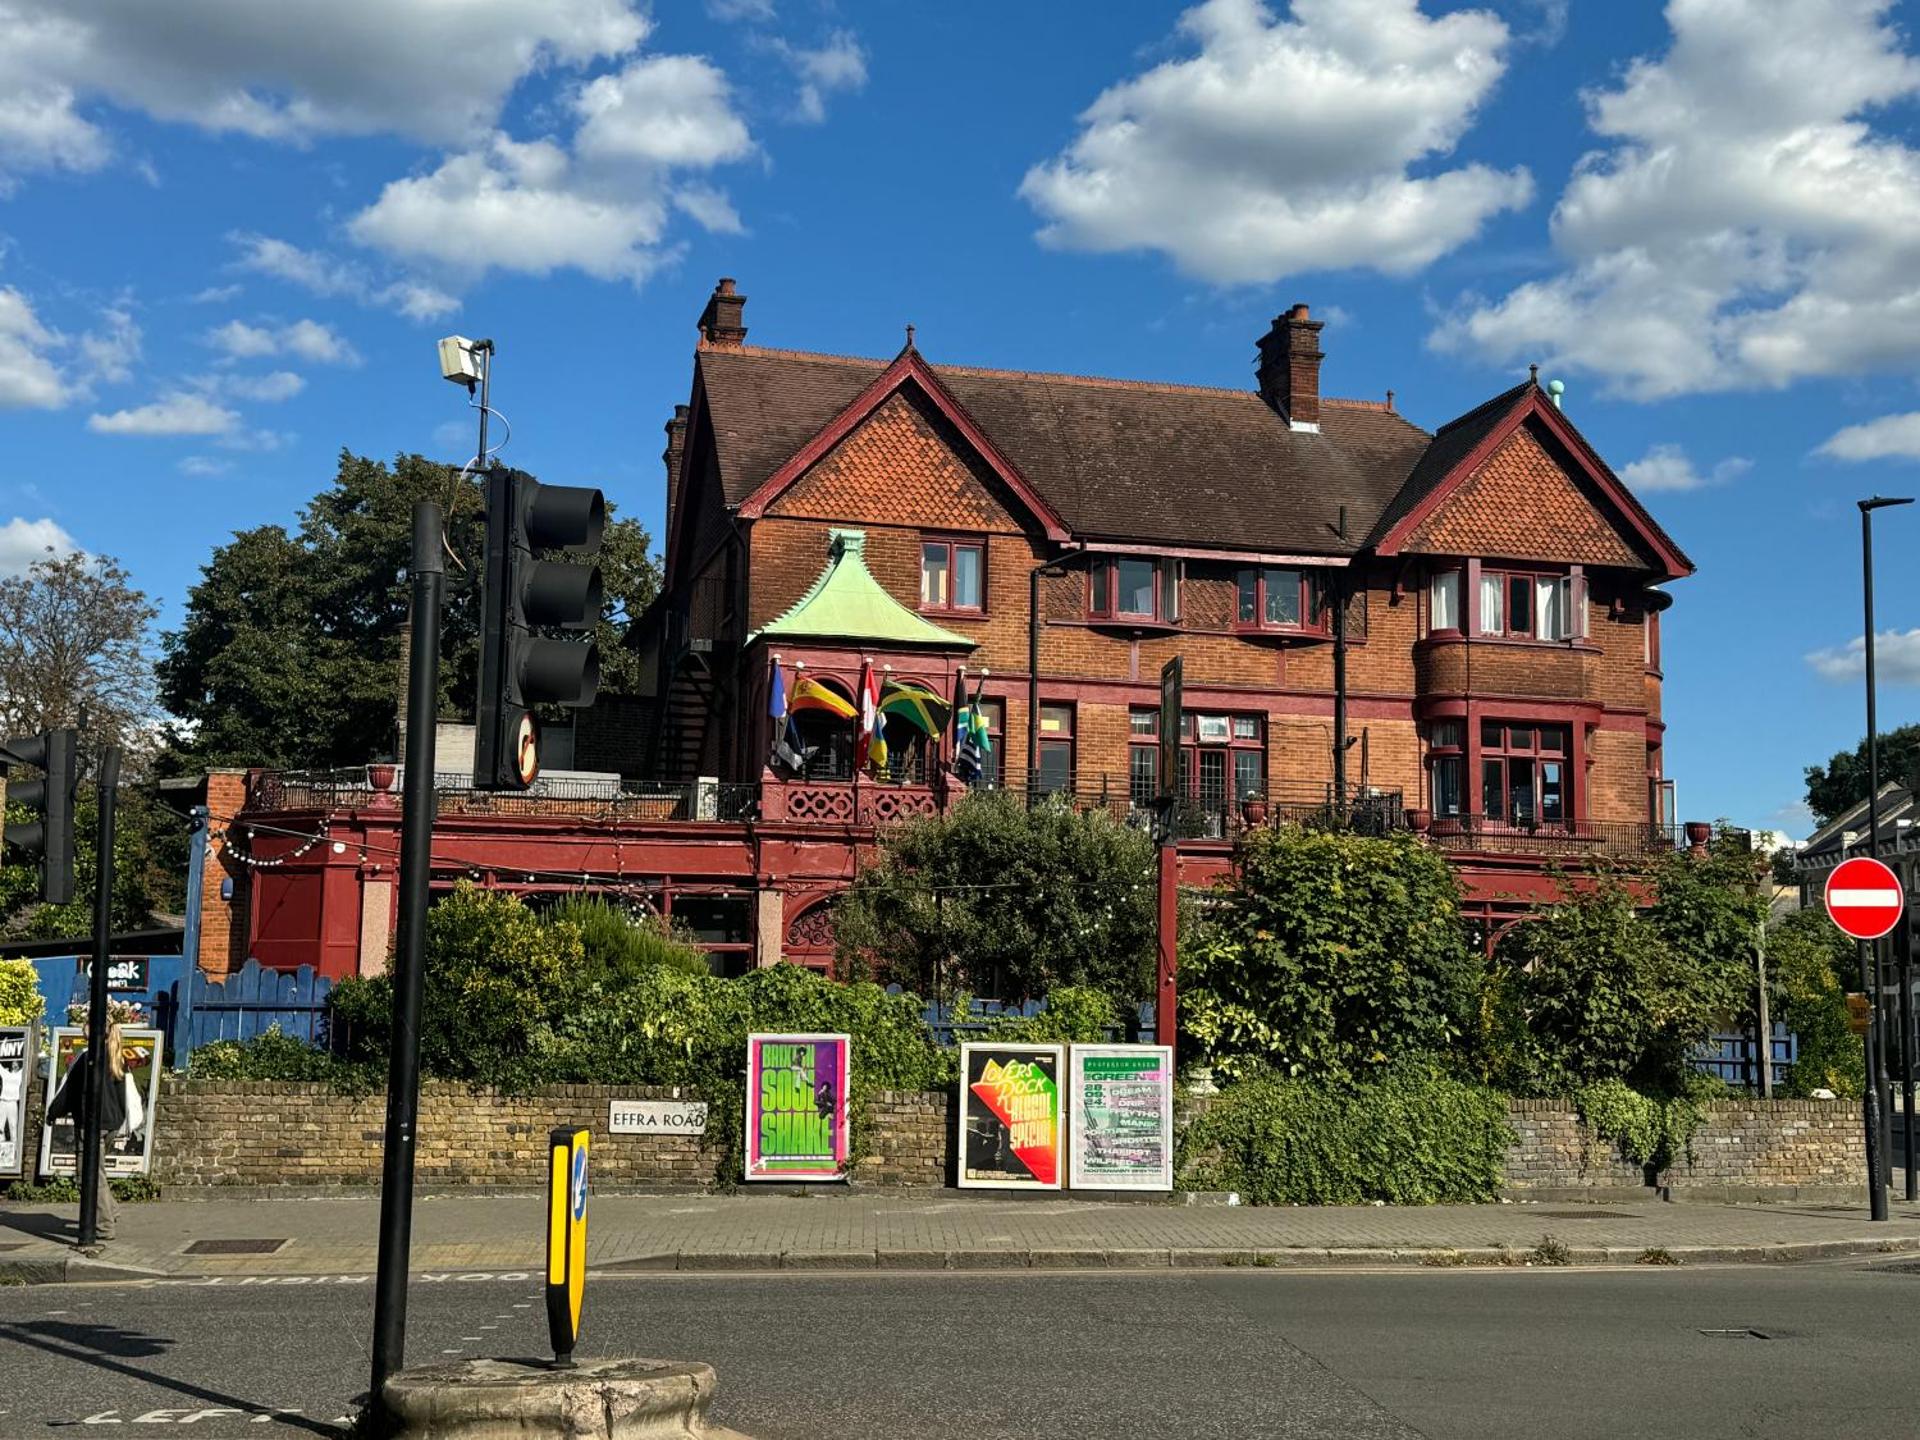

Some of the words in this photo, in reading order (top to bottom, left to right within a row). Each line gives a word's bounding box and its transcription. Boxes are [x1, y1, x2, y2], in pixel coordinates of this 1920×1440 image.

[762, 1044, 815, 1068] BRIXTN
[761, 1069, 818, 1111] SOUL
[613, 1112, 657, 1126] EFFRA
[663, 1114, 705, 1127] ROAD
[761, 1112, 834, 1155] SHAKE
